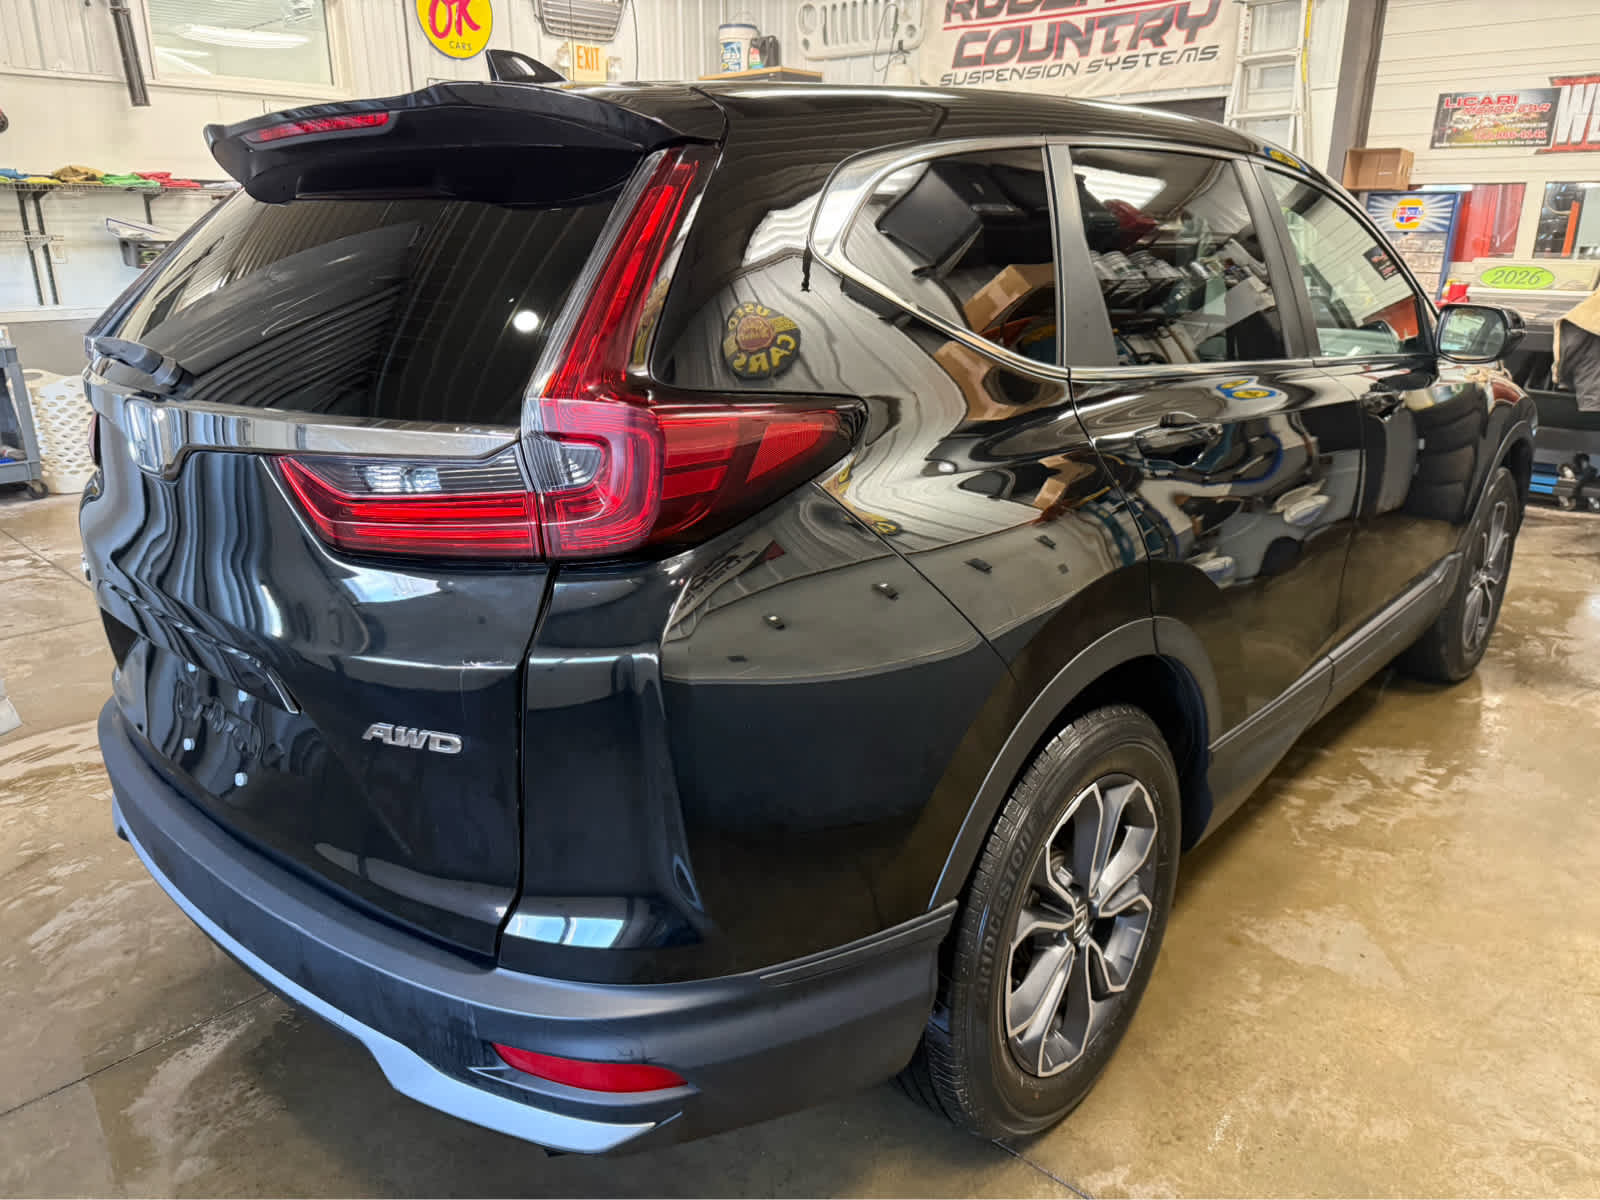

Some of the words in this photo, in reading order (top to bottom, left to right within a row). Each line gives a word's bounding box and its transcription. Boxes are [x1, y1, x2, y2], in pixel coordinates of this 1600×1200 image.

[429, 0, 481, 39] OK
[449, 41, 472, 51] CARS
[952, 0, 1222, 69] COUNTRY
[576, 45, 600, 72] EXIT
[940, 60, 1080, 87] SUSPENSION
[1085, 45, 1220, 74] SYSTEMS
[1444, 94, 1520, 109] LICARI
[1490, 269, 1545, 286] 2026
[362, 722, 463, 754] AWD
